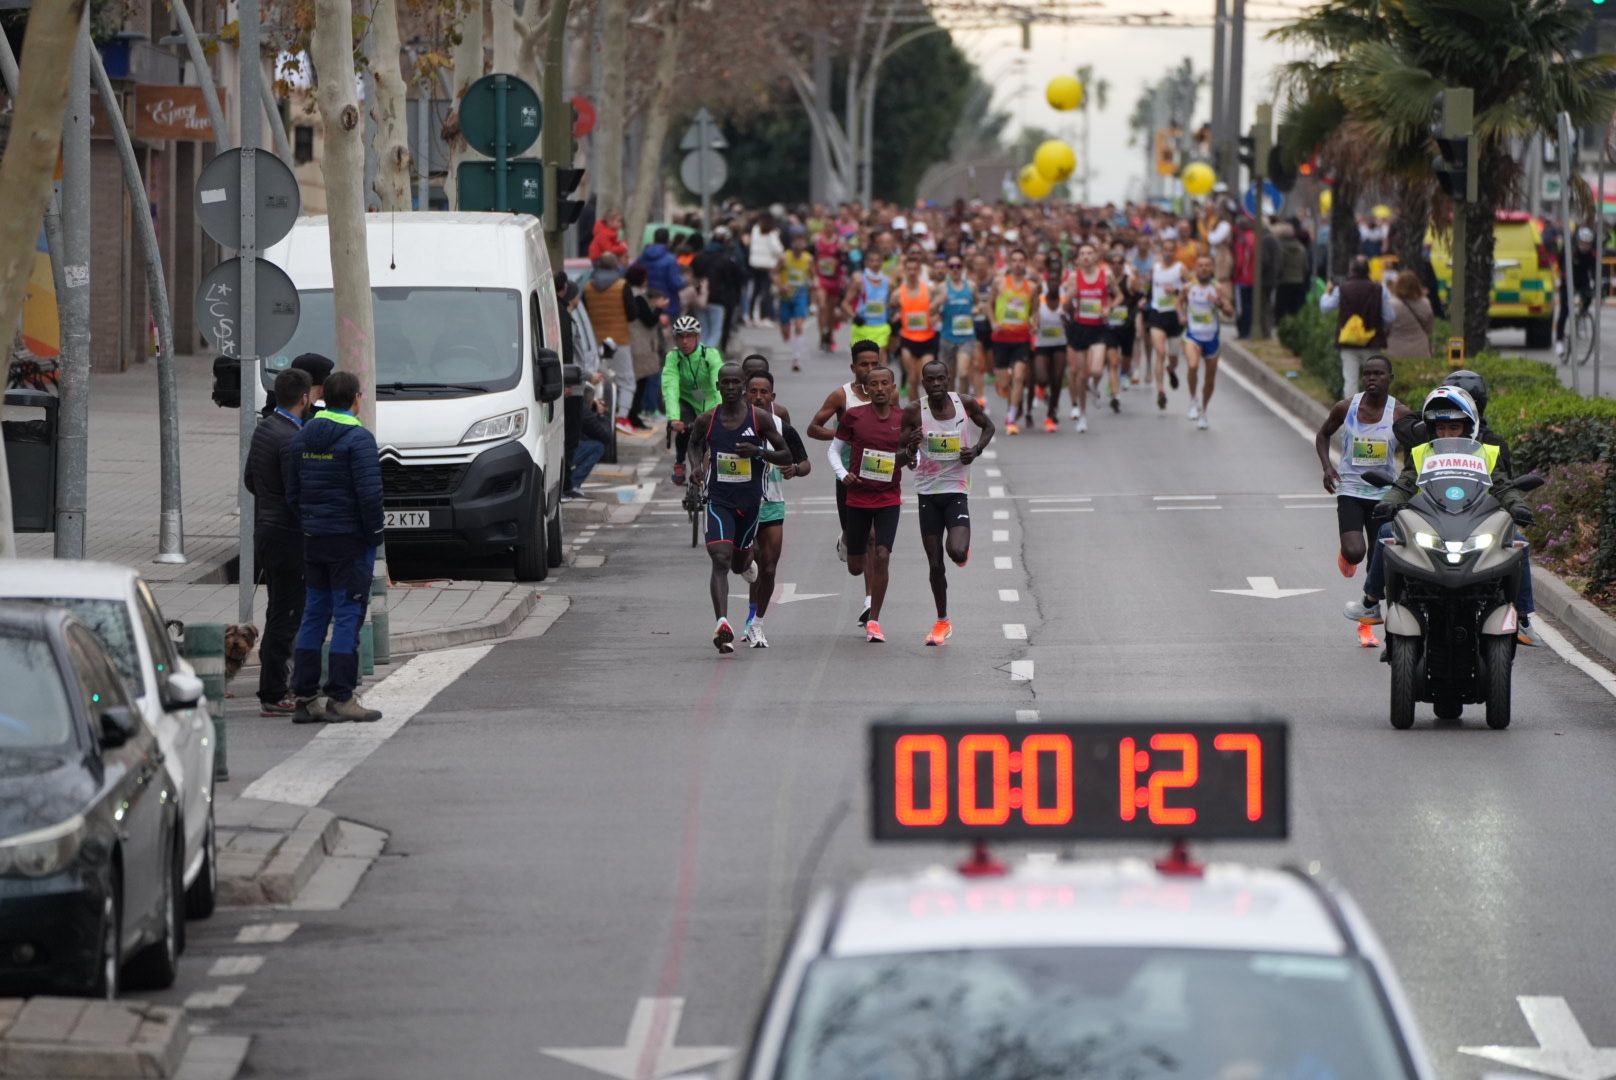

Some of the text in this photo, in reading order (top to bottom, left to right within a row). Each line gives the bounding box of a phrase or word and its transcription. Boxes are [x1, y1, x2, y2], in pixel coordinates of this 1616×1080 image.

[940, 438, 947, 449] 4
[1366, 443, 1373, 454] 3
[730, 460, 736, 471] 9
[876, 459, 881, 469] 1
[1438, 458, 1483, 471] YAMAHA
[399, 512, 425, 526] KTX
